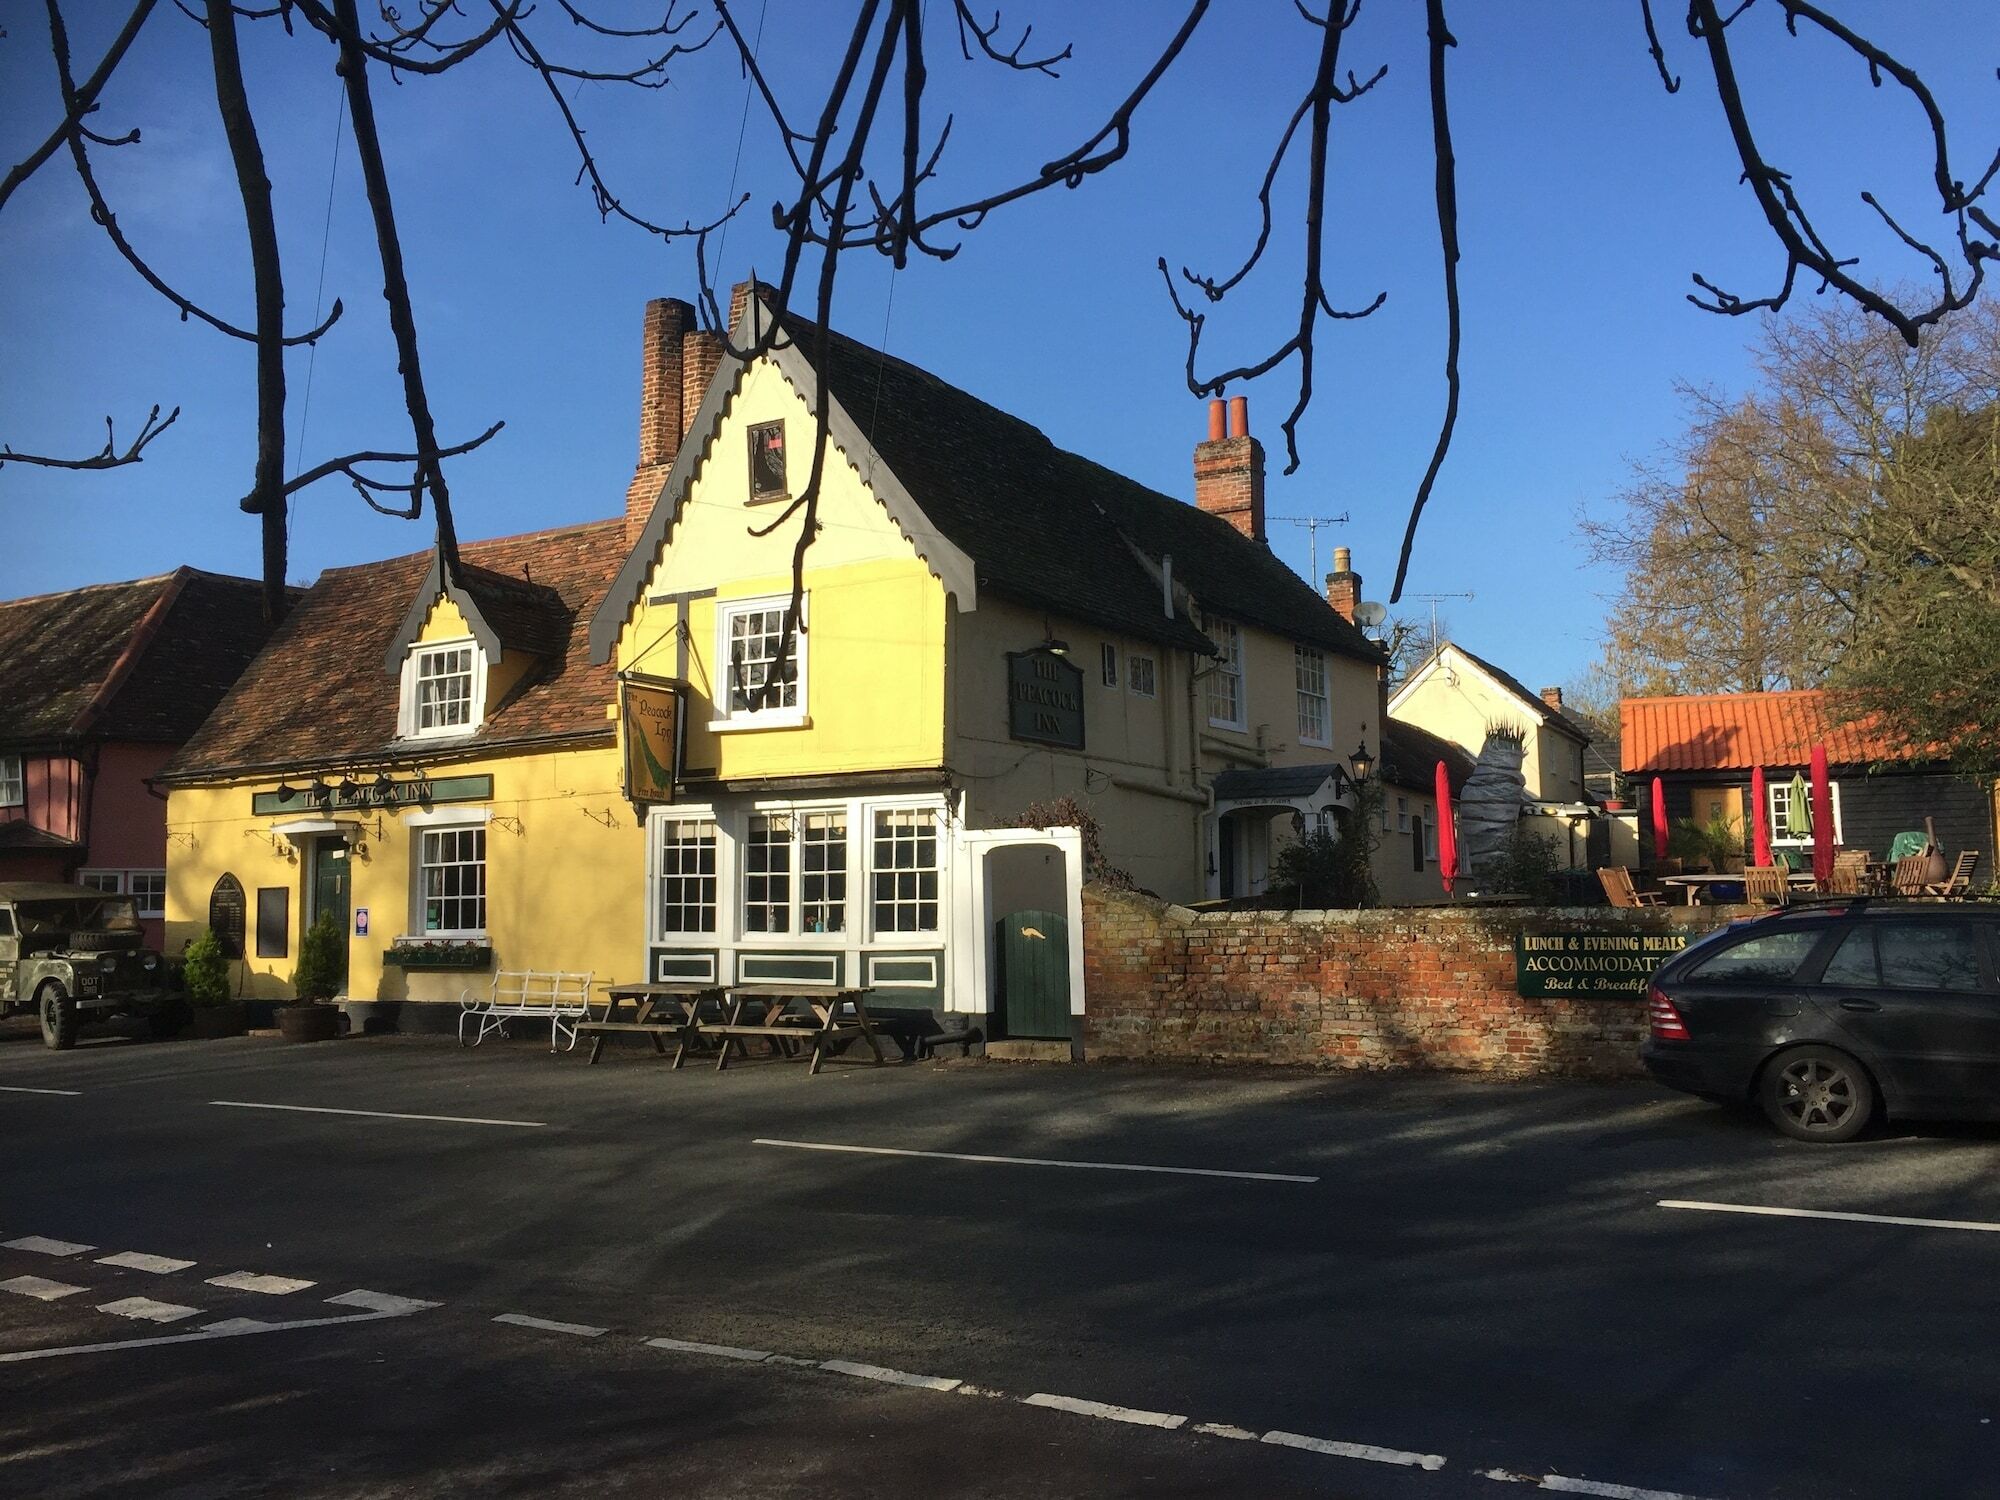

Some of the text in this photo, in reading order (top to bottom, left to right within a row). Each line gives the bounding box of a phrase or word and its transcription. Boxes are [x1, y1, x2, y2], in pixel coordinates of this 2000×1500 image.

[1032, 658, 1058, 680] THE
[1016, 681, 1078, 711] PEACOCK
[639, 699, 672, 719] Peacock
[655, 721, 671, 742] Inn
[1034, 711, 1063, 736] INN
[303, 791, 328, 807] TH
[405, 782, 433, 800] INN
[1524, 936, 1686, 951] LUNCH & EVENING MEALS
[1544, 977, 1573, 990] Bed
[1577, 977, 1589, 990] &
